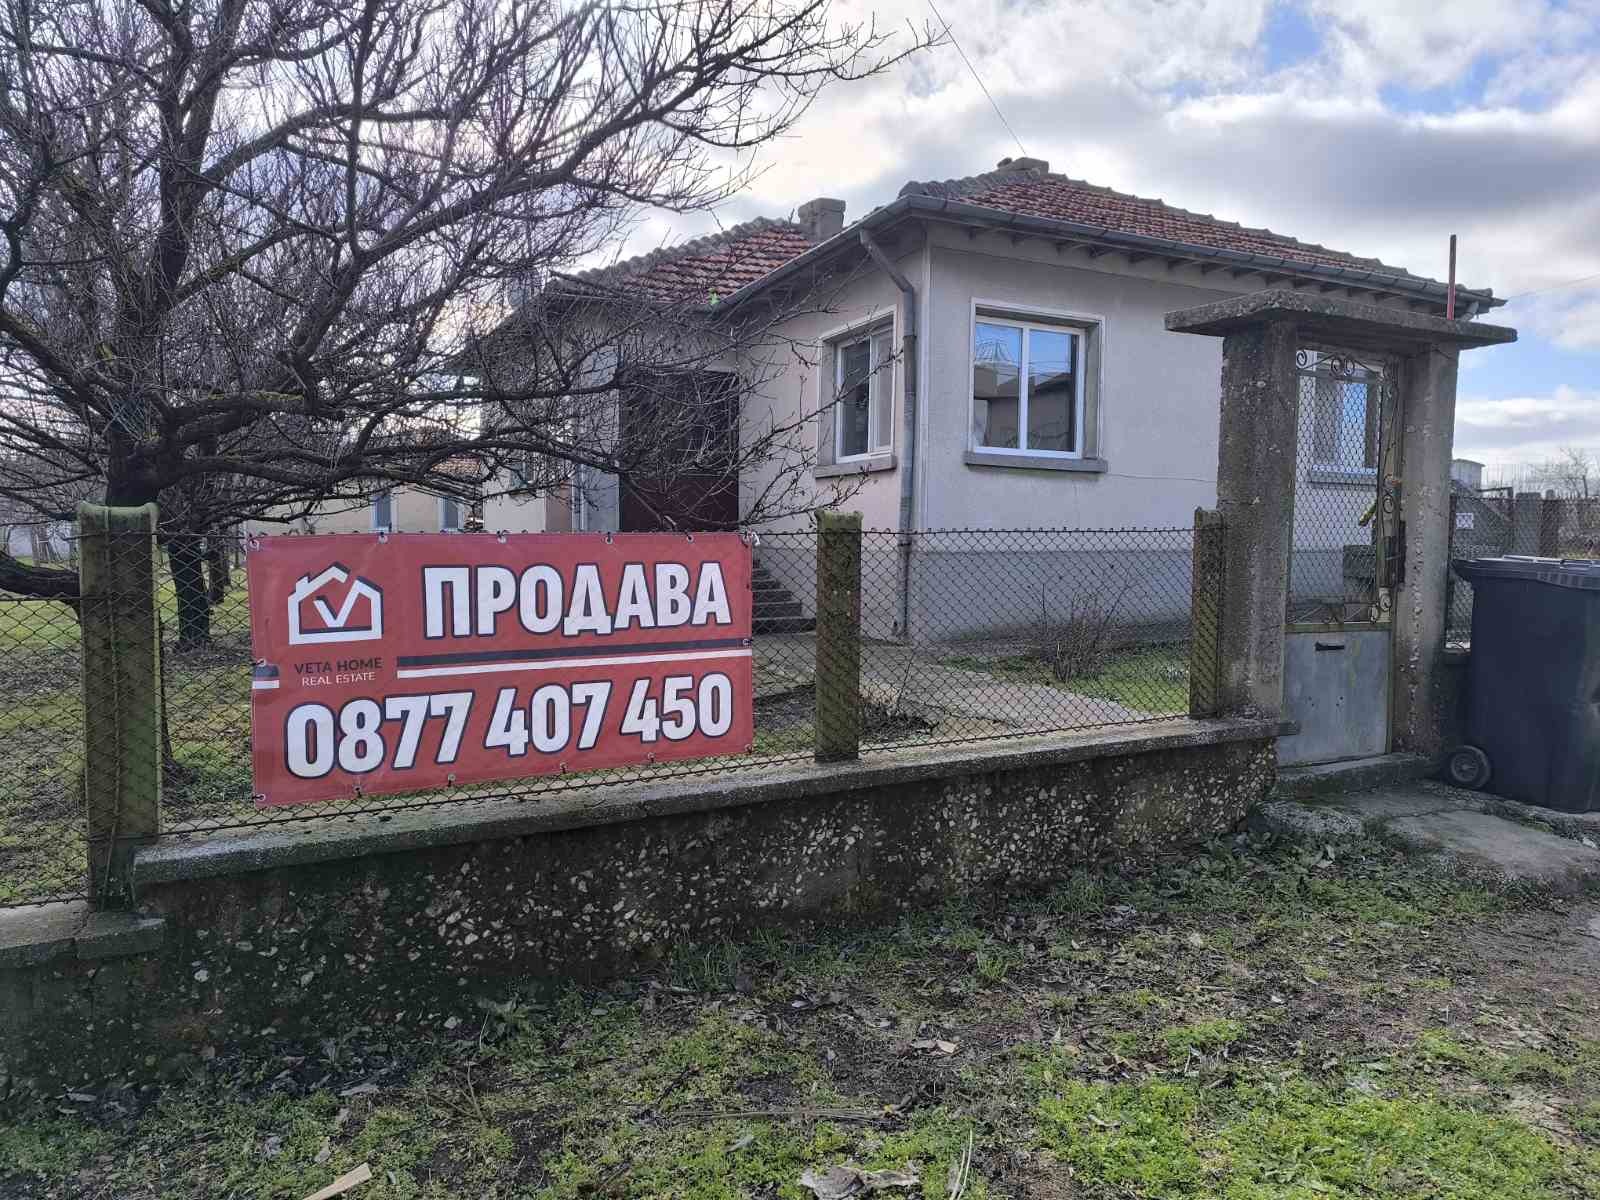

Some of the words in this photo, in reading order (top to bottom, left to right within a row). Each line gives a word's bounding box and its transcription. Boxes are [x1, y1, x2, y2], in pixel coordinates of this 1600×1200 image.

[422, 561, 732, 639] ПРОДАВА
[294, 662, 332, 674] VETA
[337, 657, 383, 671] HOME
[302, 676, 332, 686] REAL
[336, 672, 376, 684] ESTATE
[285, 690, 474, 779] 0877
[484, 681, 612, 757] 407
[620, 672, 733, 743] 450
